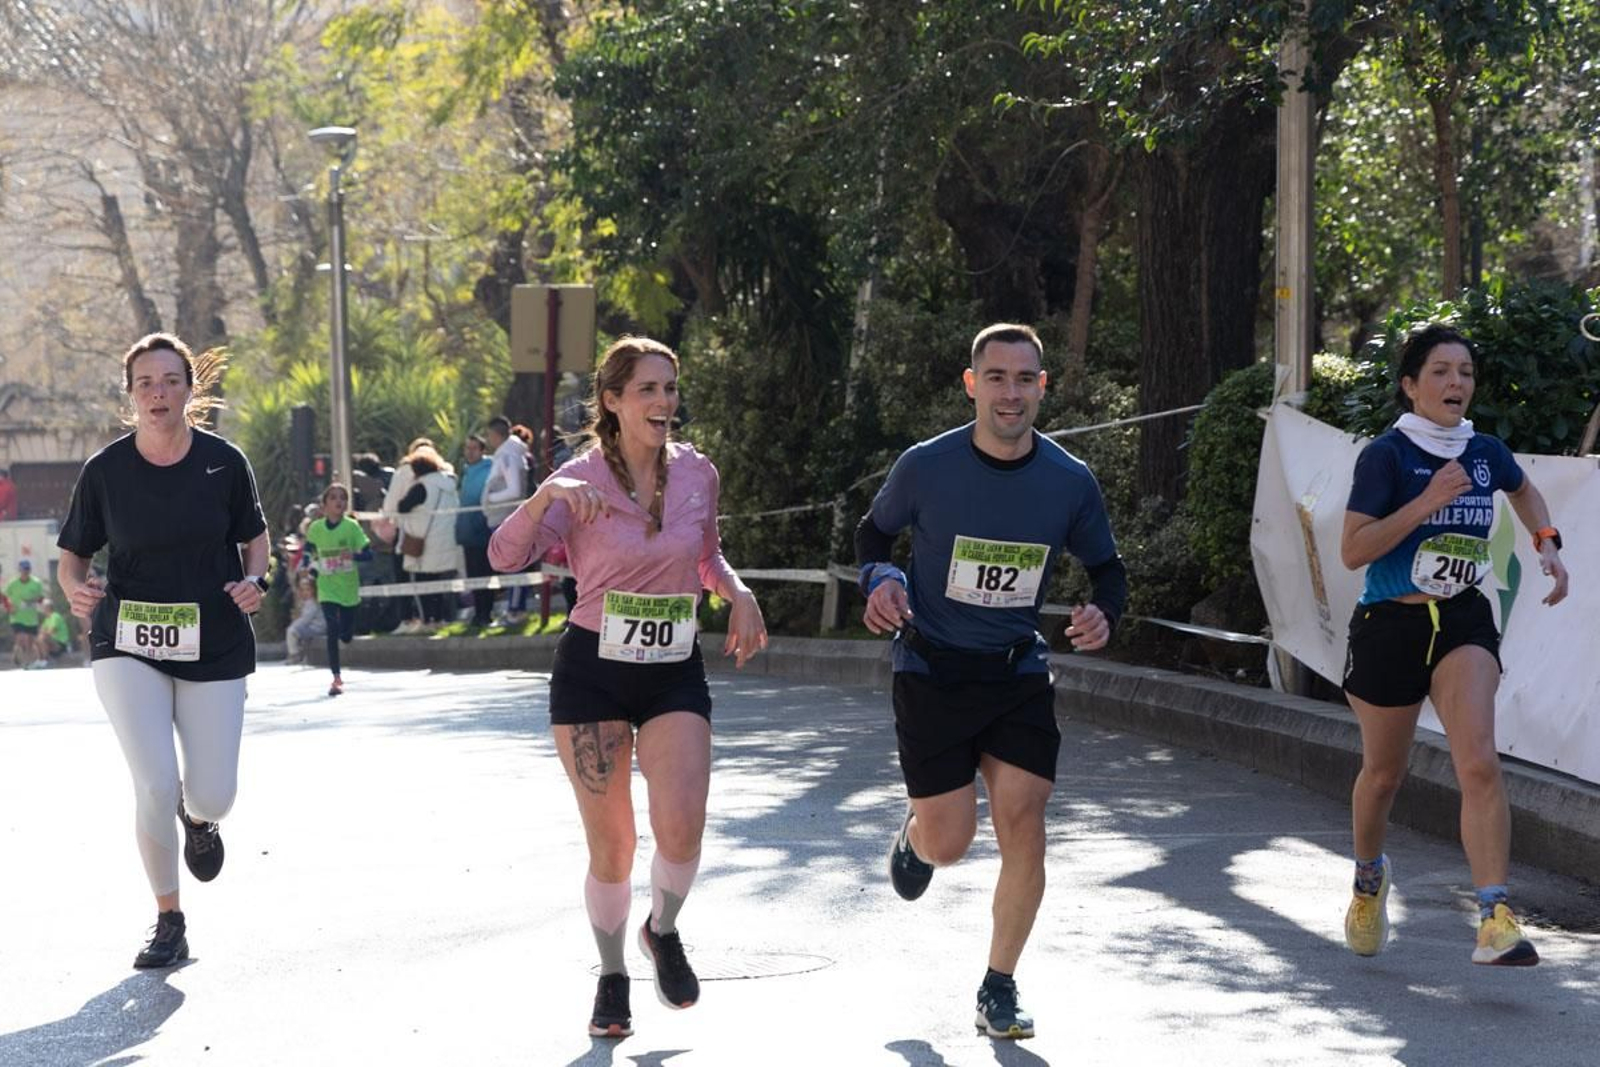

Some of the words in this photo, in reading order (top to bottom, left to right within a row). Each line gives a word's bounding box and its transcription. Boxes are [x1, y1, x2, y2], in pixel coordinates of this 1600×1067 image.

[976, 564, 1019, 591] 182
[1432, 556, 1476, 585] 240
[136, 624, 179, 648] 690
[624, 620, 673, 647] 790
